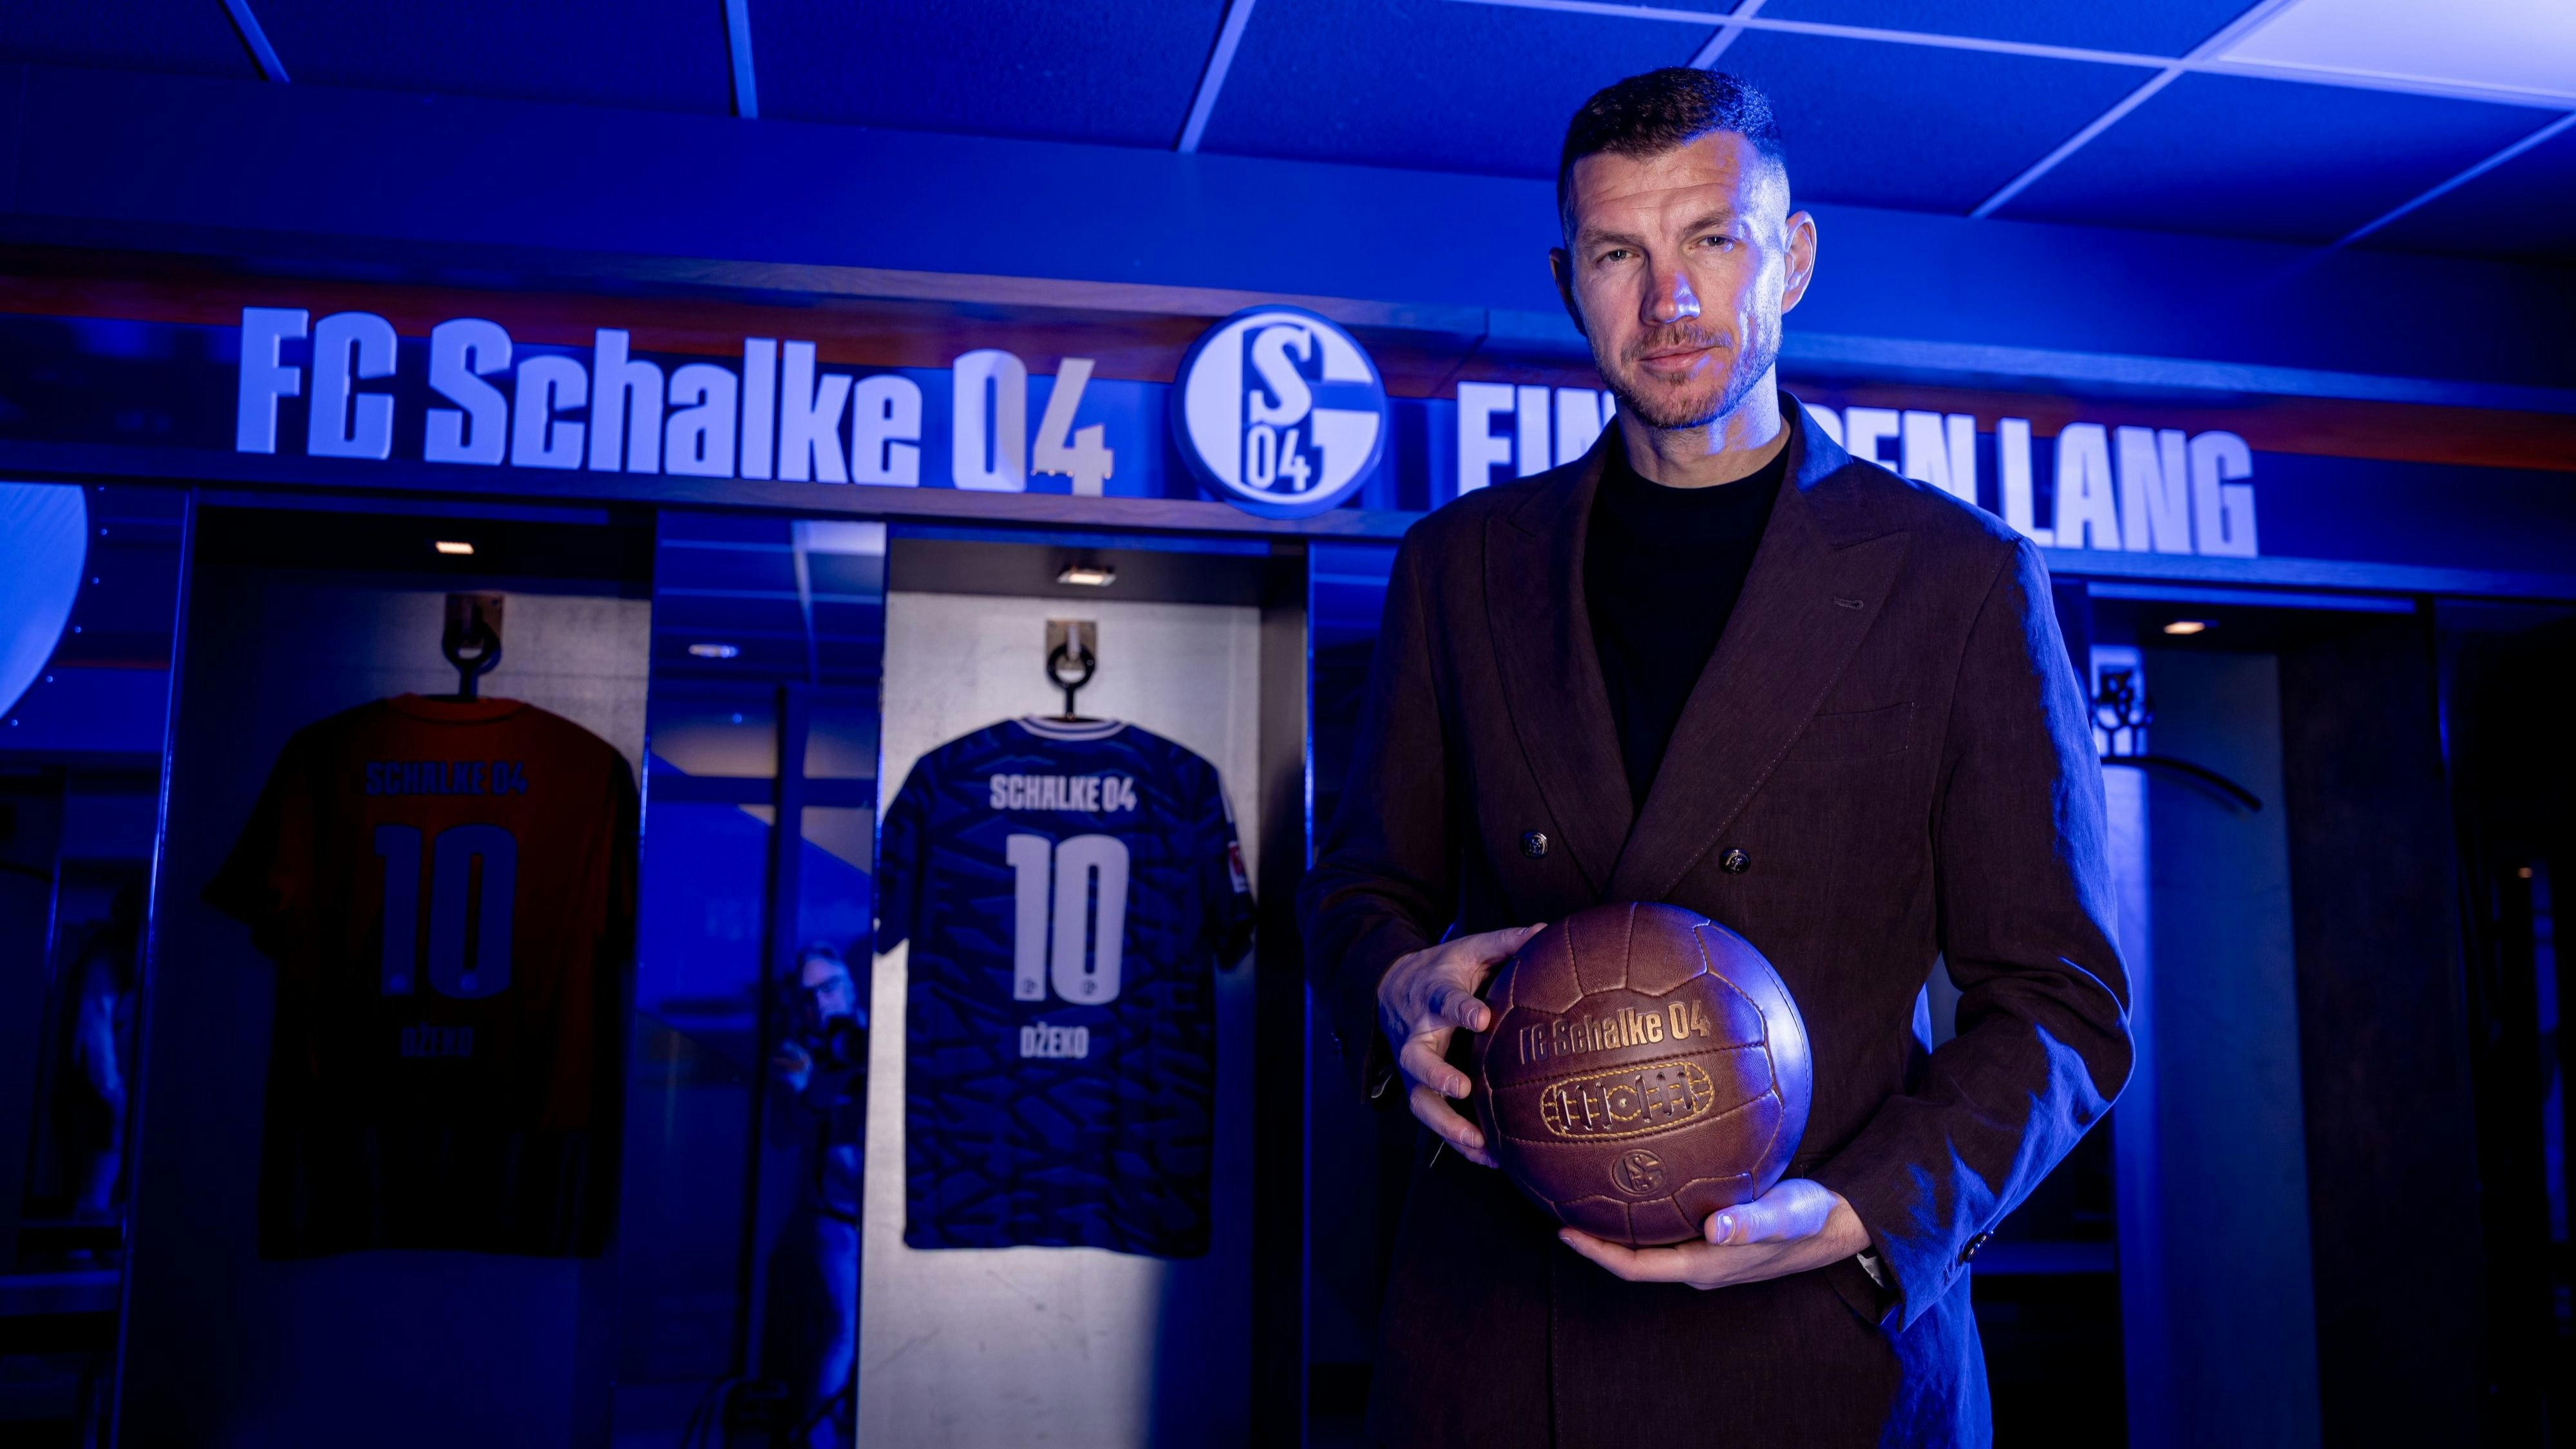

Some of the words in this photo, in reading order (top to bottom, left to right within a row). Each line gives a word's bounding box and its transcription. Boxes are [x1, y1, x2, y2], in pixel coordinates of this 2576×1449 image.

[236, 305, 398, 460] FC
[423, 317, 922, 489] Schalke
[952, 348, 1114, 497] 04
[1998, 417, 2259, 559] LANG
[365, 760, 486, 796] SCHALKE
[490, 760, 528, 796] 04
[989, 773, 1101, 813] SCHALKE
[1101, 775, 1138, 813] 04
[373, 821, 518, 999] 10
[1005, 833, 1130, 1005] 10
[1019, 1021, 1090, 1059] DŽEKO
[1520, 1023, 1549, 1065] FC
[1553, 1007, 1662, 1056] Schalke
[1668, 999, 1710, 1039] 04
